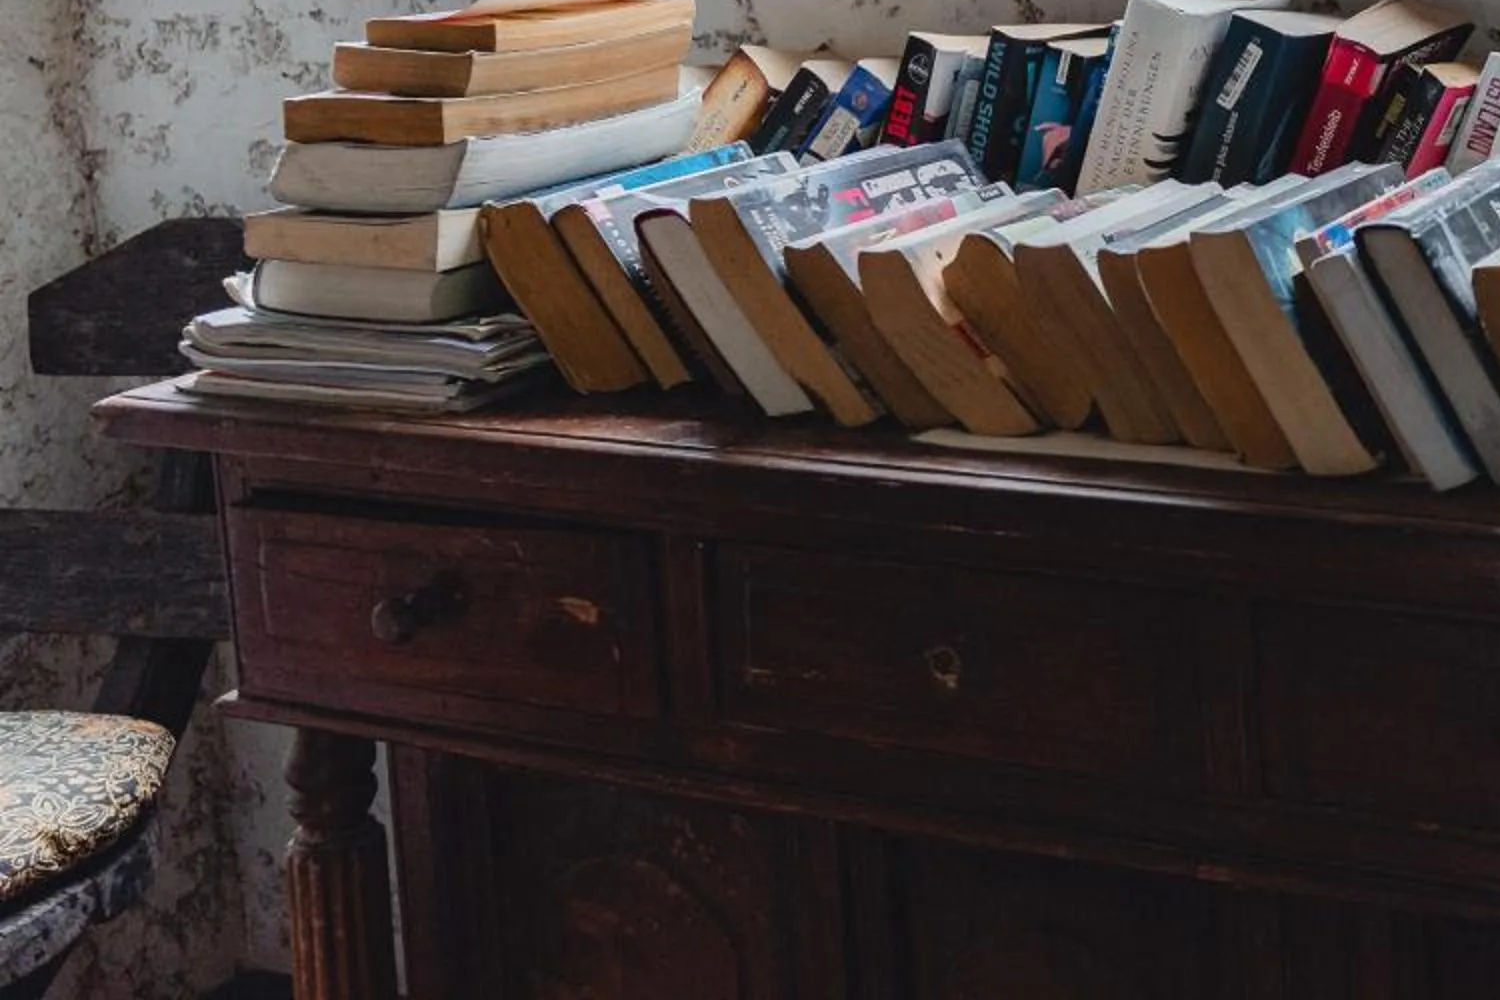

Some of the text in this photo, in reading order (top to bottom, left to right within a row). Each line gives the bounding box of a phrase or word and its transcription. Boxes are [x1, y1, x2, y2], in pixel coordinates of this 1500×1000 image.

[886, 85, 917, 138] DEBT
[970, 38, 1008, 160] WILD SHOR
[1120, 87, 1138, 118] DER
[1125, 49, 1164, 176] ERINNERUNGEN
